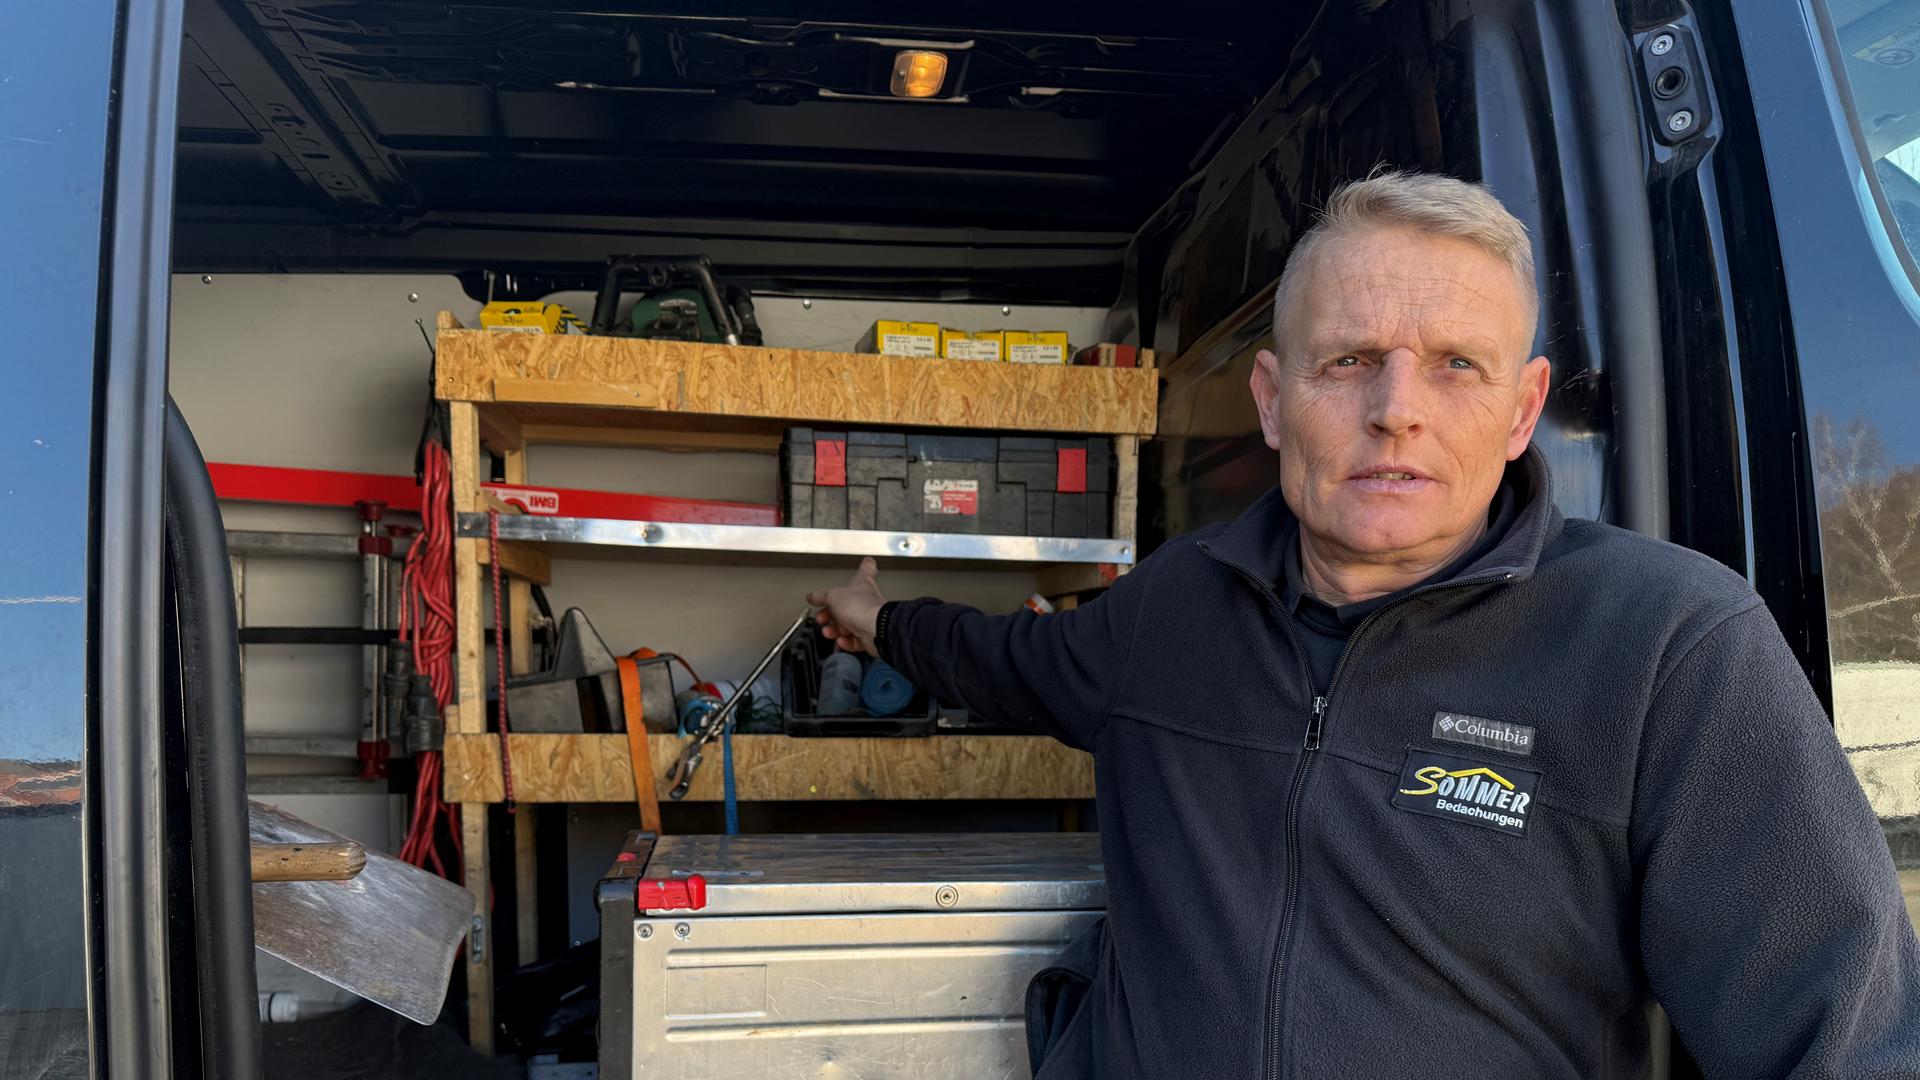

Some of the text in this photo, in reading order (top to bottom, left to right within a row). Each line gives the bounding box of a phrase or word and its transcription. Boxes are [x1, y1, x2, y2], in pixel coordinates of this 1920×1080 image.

[1455, 719, 1528, 746] Columbia
[1400, 766, 1530, 814] SOMMER
[1436, 799, 1523, 828] Bedachungen
